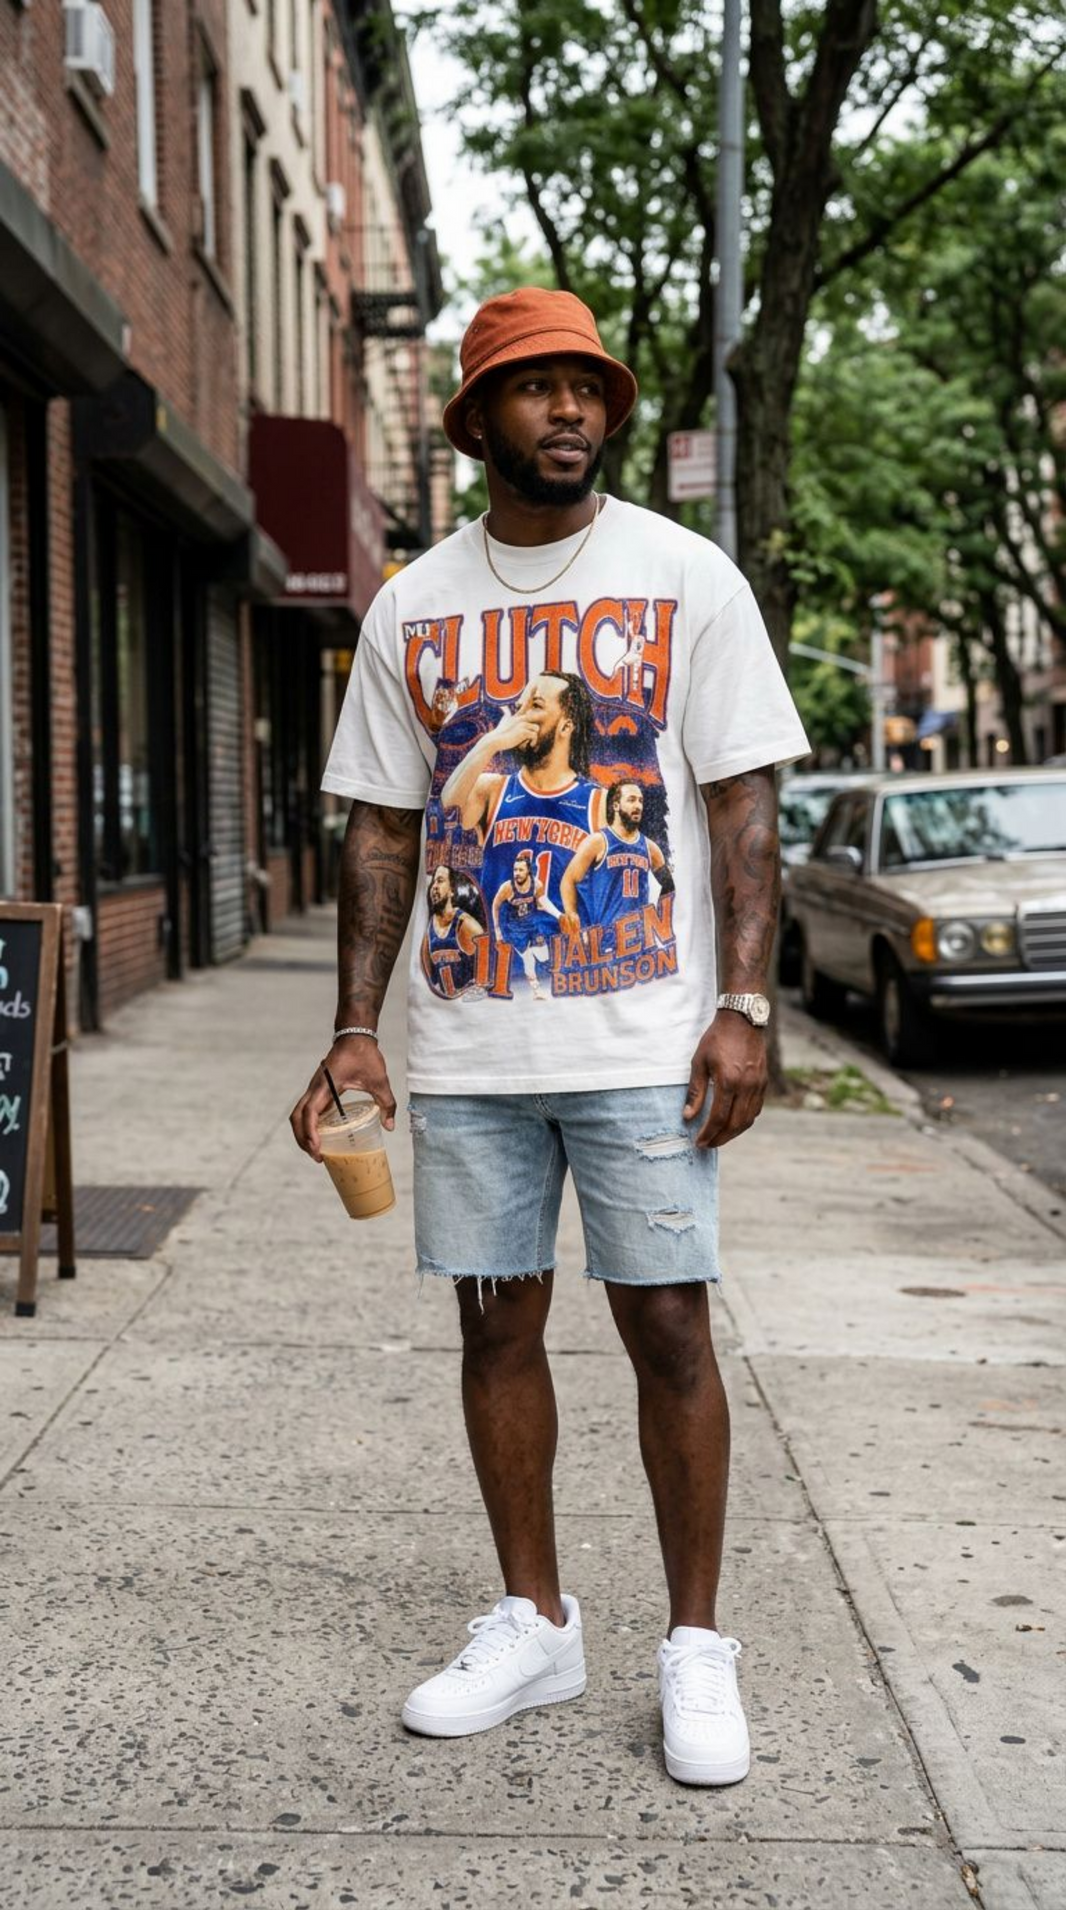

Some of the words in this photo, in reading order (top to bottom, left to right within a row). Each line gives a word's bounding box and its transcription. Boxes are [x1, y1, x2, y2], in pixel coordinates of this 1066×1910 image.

[402, 597, 678, 733] CLUTCH
[622, 868, 639, 898] 11
[550, 891, 677, 973] JALEN
[472, 933, 513, 1000] 11
[551, 943, 679, 998] BRUNSON
